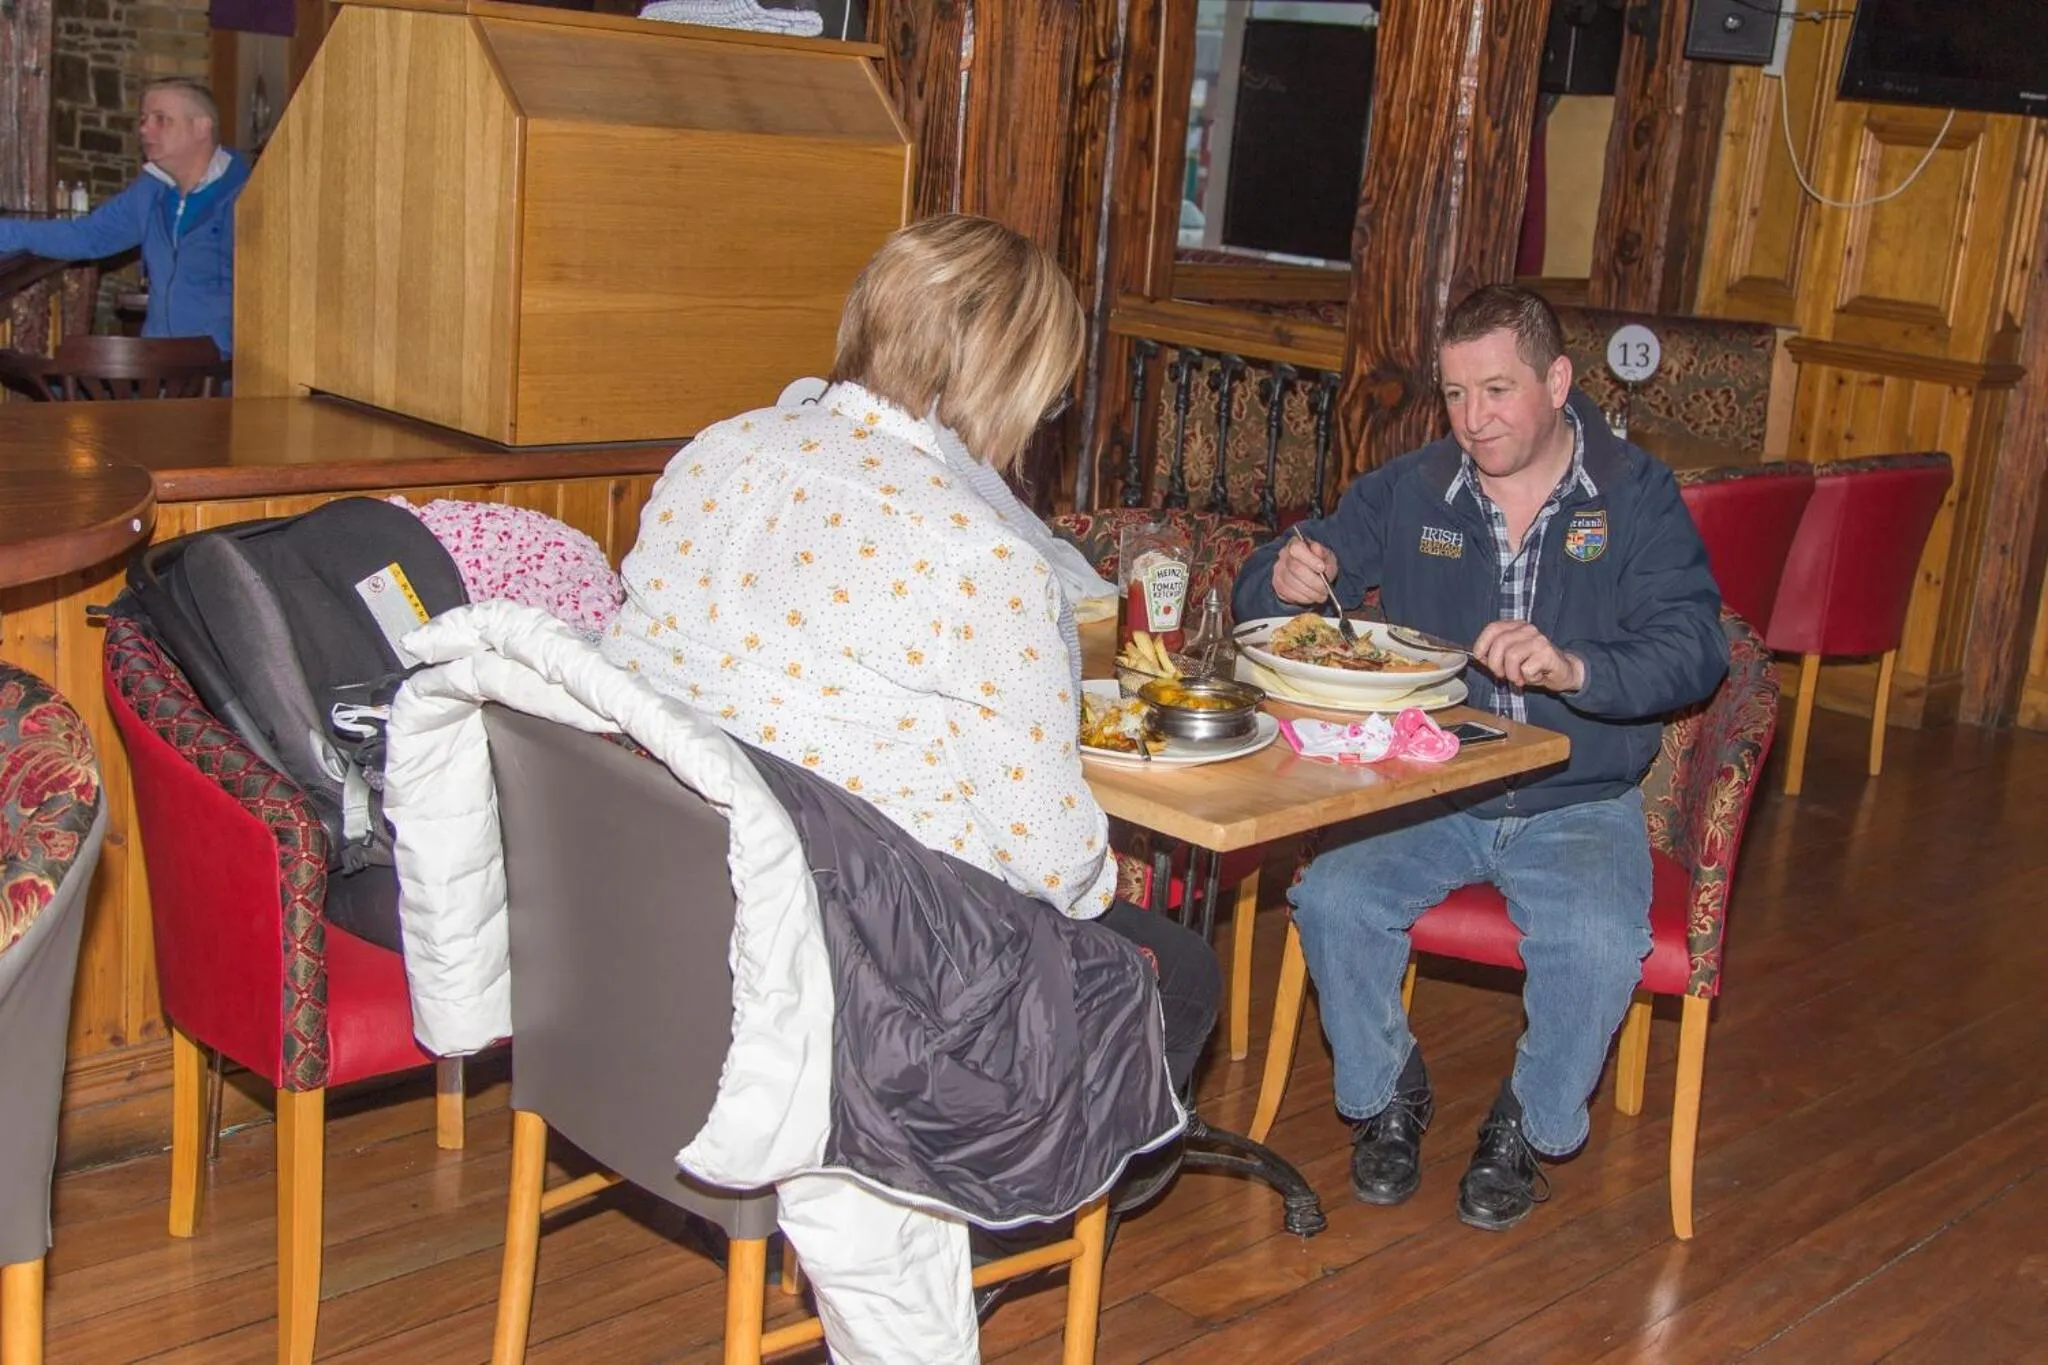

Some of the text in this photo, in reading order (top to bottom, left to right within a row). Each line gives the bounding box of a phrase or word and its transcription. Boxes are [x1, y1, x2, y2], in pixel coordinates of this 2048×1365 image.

[1618, 342, 1650, 368] 13
[1421, 526, 1463, 546] IRISH
[1157, 568, 1181, 578] HEINZ
